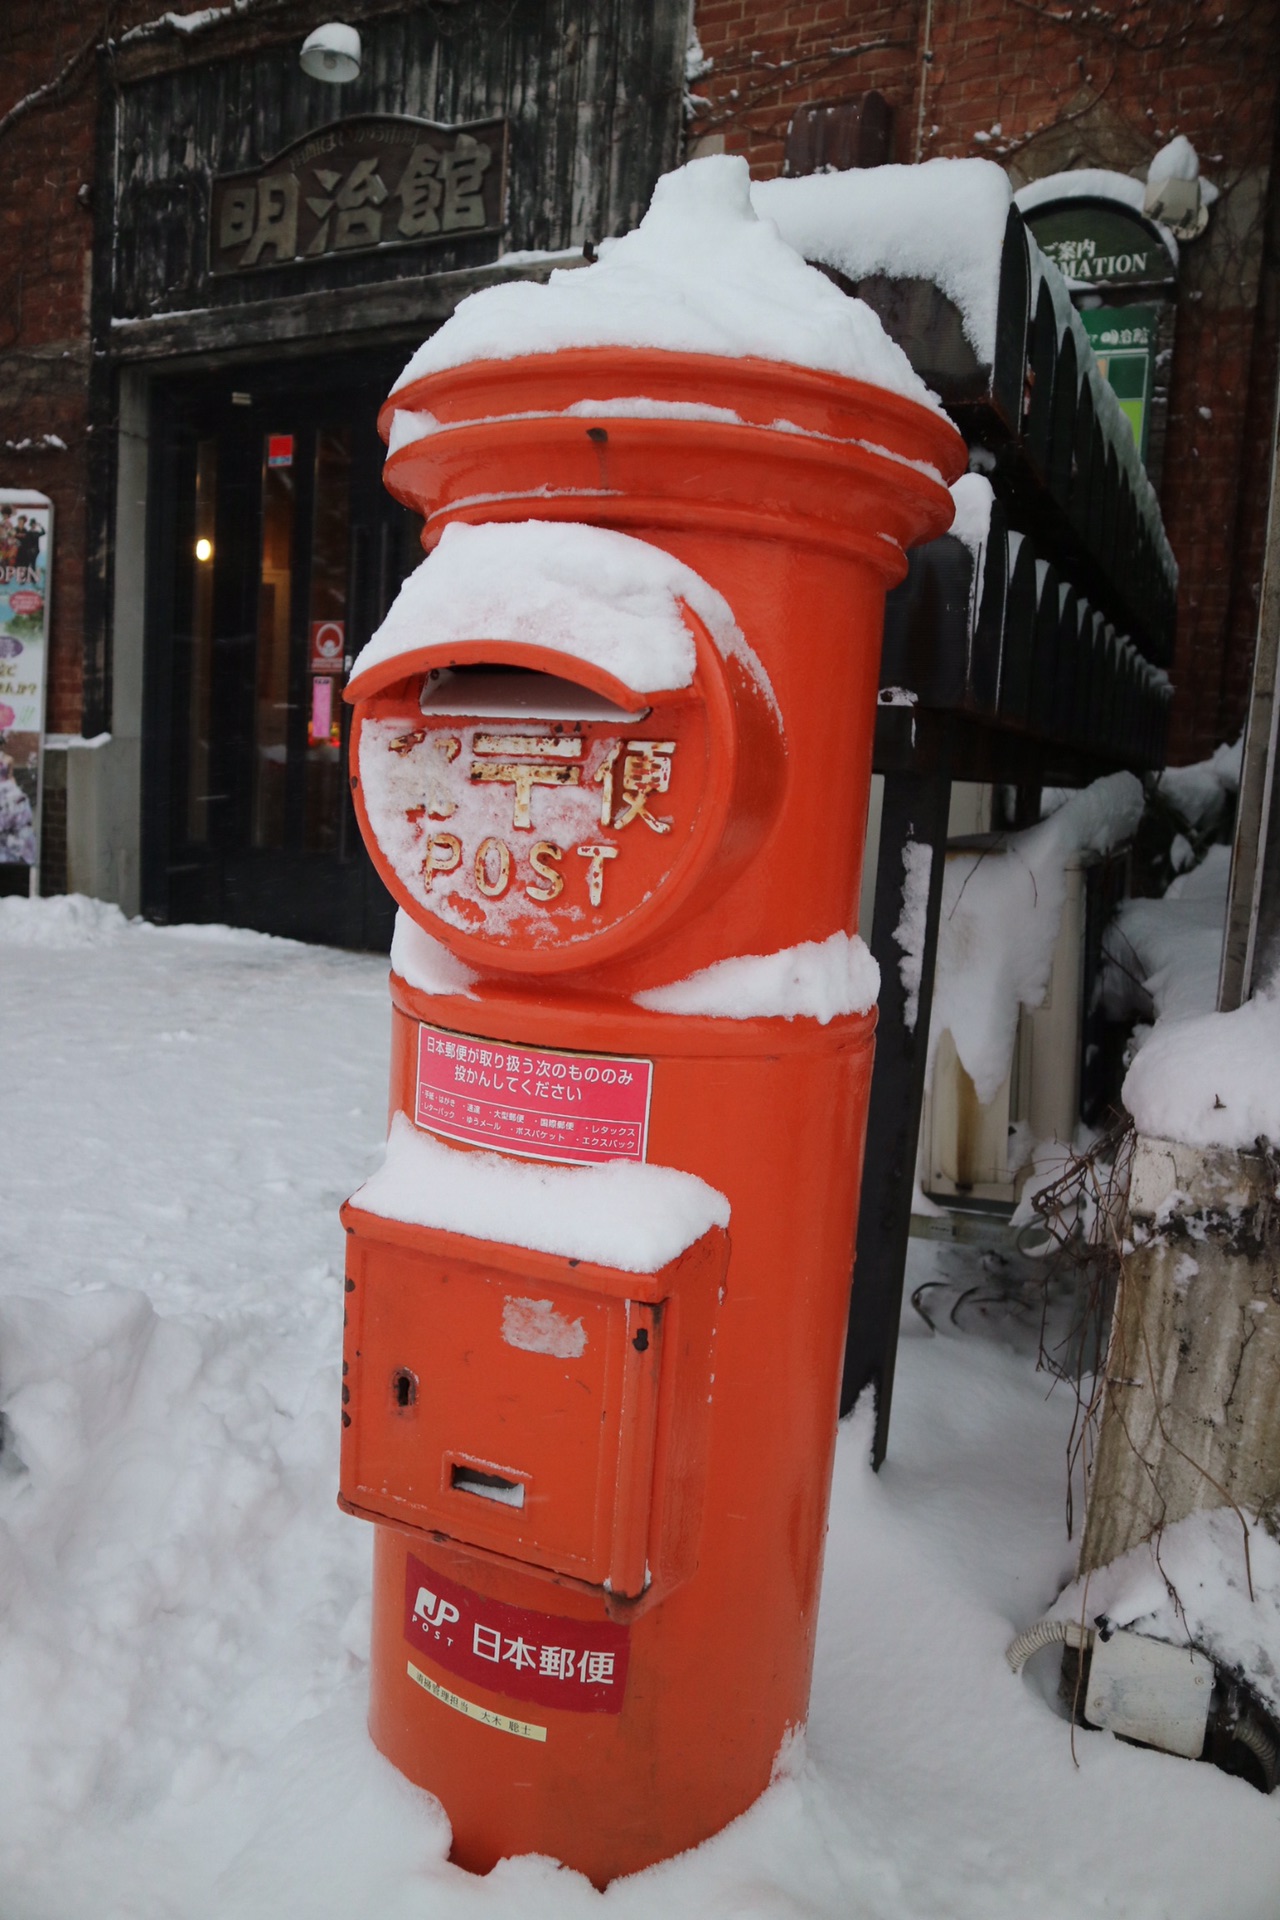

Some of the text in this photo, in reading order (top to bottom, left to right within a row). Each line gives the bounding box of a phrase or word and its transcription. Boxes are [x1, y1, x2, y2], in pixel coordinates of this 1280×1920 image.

[220, 133, 491, 266] 明治館
[1044, 239, 1096, 260] ご案内
[1060, 252, 1148, 279] MATION
[424, 833, 618, 907] POST
[427, 1036, 633, 1085] 日本郵便が取り扱う次のもののみ
[454, 1065, 582, 1101] 投かんしてください
[412, 1614, 454, 1647] POST
[473, 1622, 615, 1684] 日本郵便
